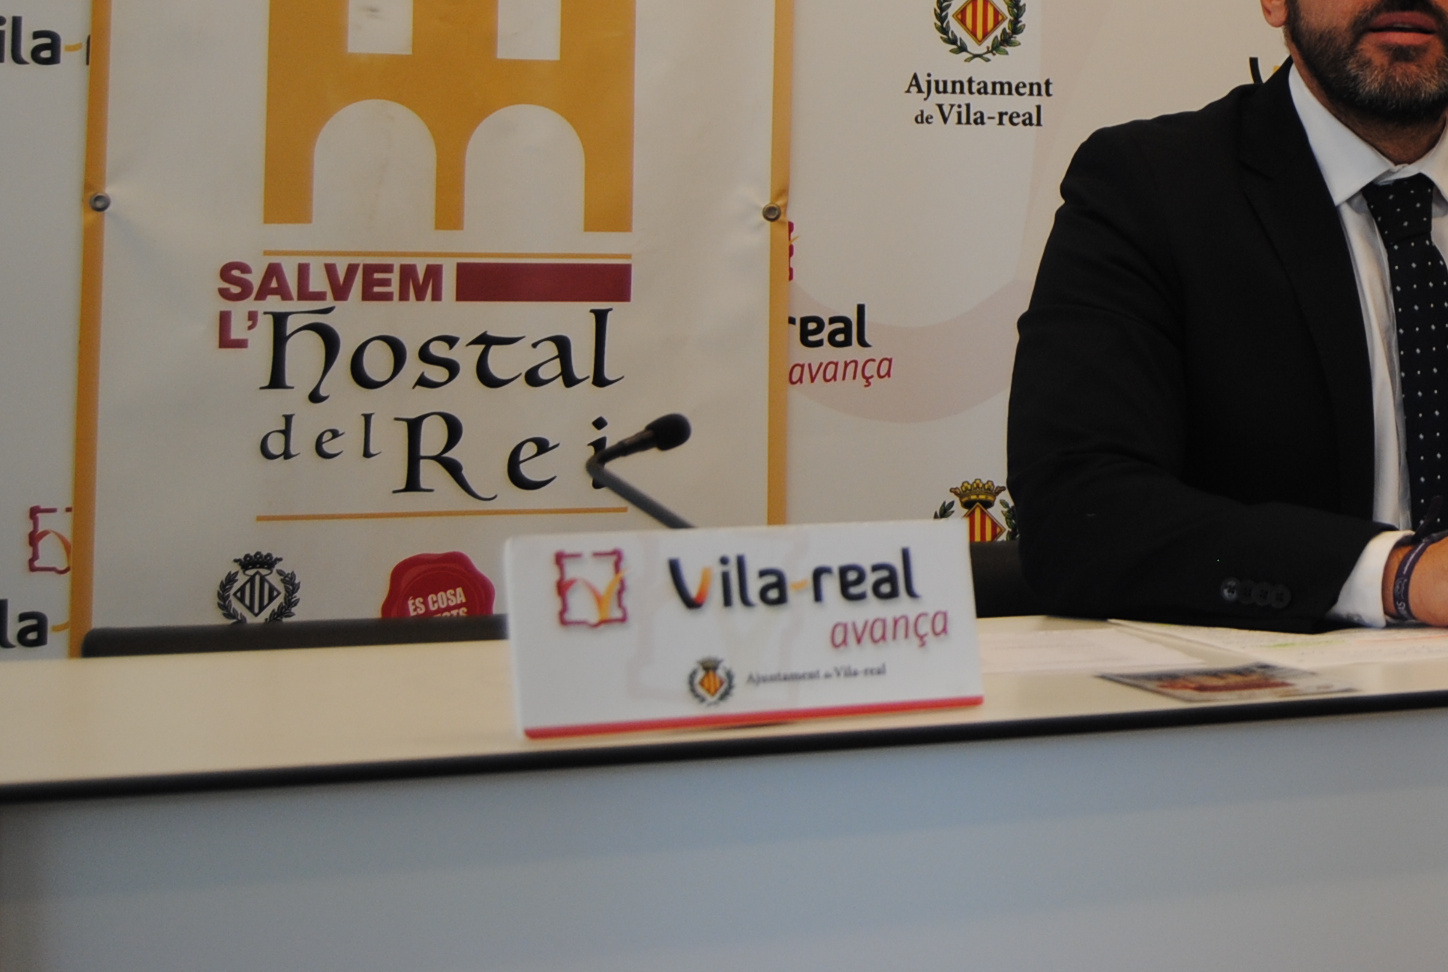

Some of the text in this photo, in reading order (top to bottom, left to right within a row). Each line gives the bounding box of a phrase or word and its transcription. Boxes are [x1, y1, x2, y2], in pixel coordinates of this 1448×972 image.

[905, 72, 1052, 101] Ajuntament
[915, 103, 1042, 126] de Vila-real
[218, 262, 443, 302] SALVEM
[788, 357, 893, 388] avança
[260, 413, 381, 460] del
[668, 547, 920, 609] Vila-real
[408, 596, 426, 616] ÉS
[428, 587, 466, 611] COSA
[831, 610, 949, 648] avança
